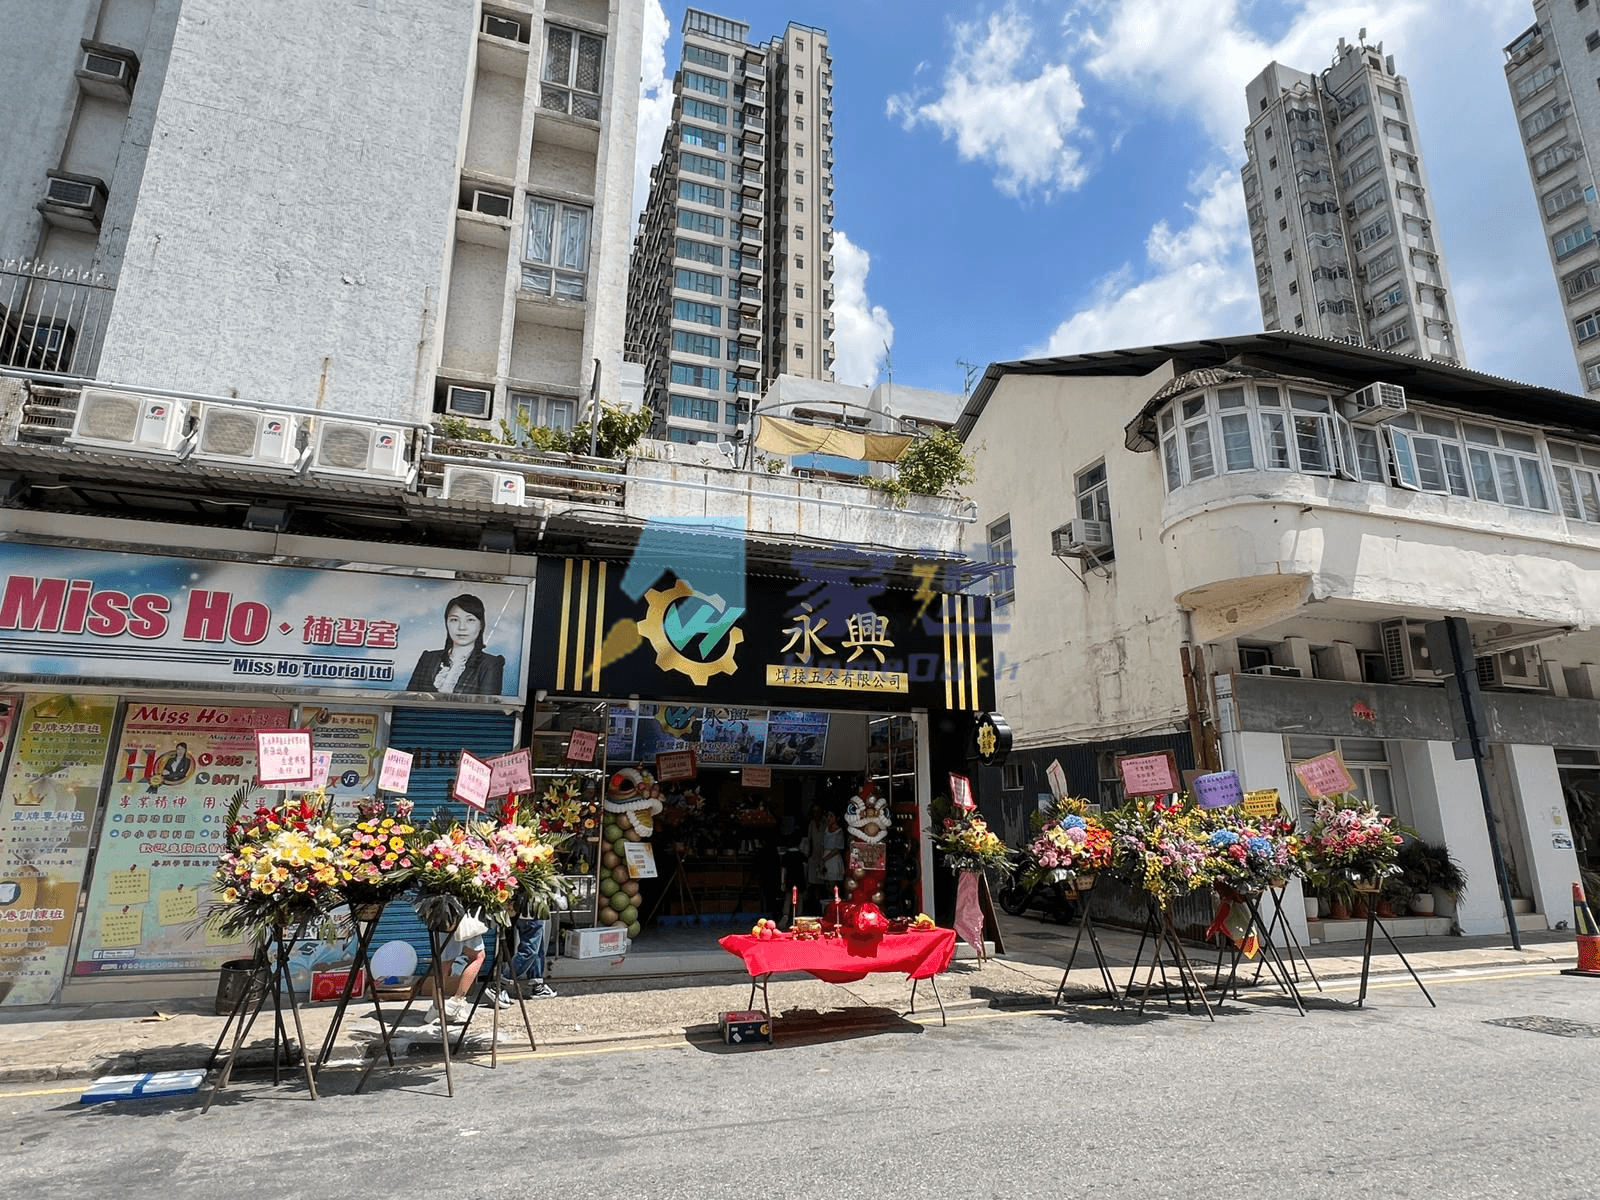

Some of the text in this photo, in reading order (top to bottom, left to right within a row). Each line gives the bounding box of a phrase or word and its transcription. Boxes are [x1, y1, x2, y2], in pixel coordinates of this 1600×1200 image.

[1, 575, 270, 645] Miss Ho
[302, 615, 399, 648] 補習室
[780, 602, 895, 664] 永興
[233, 659, 394, 680] Miss Ho Tutorial Ltd
[775, 667, 901, 690] 焊接五金有限公司
[131, 706, 229, 725] Miss Ho
